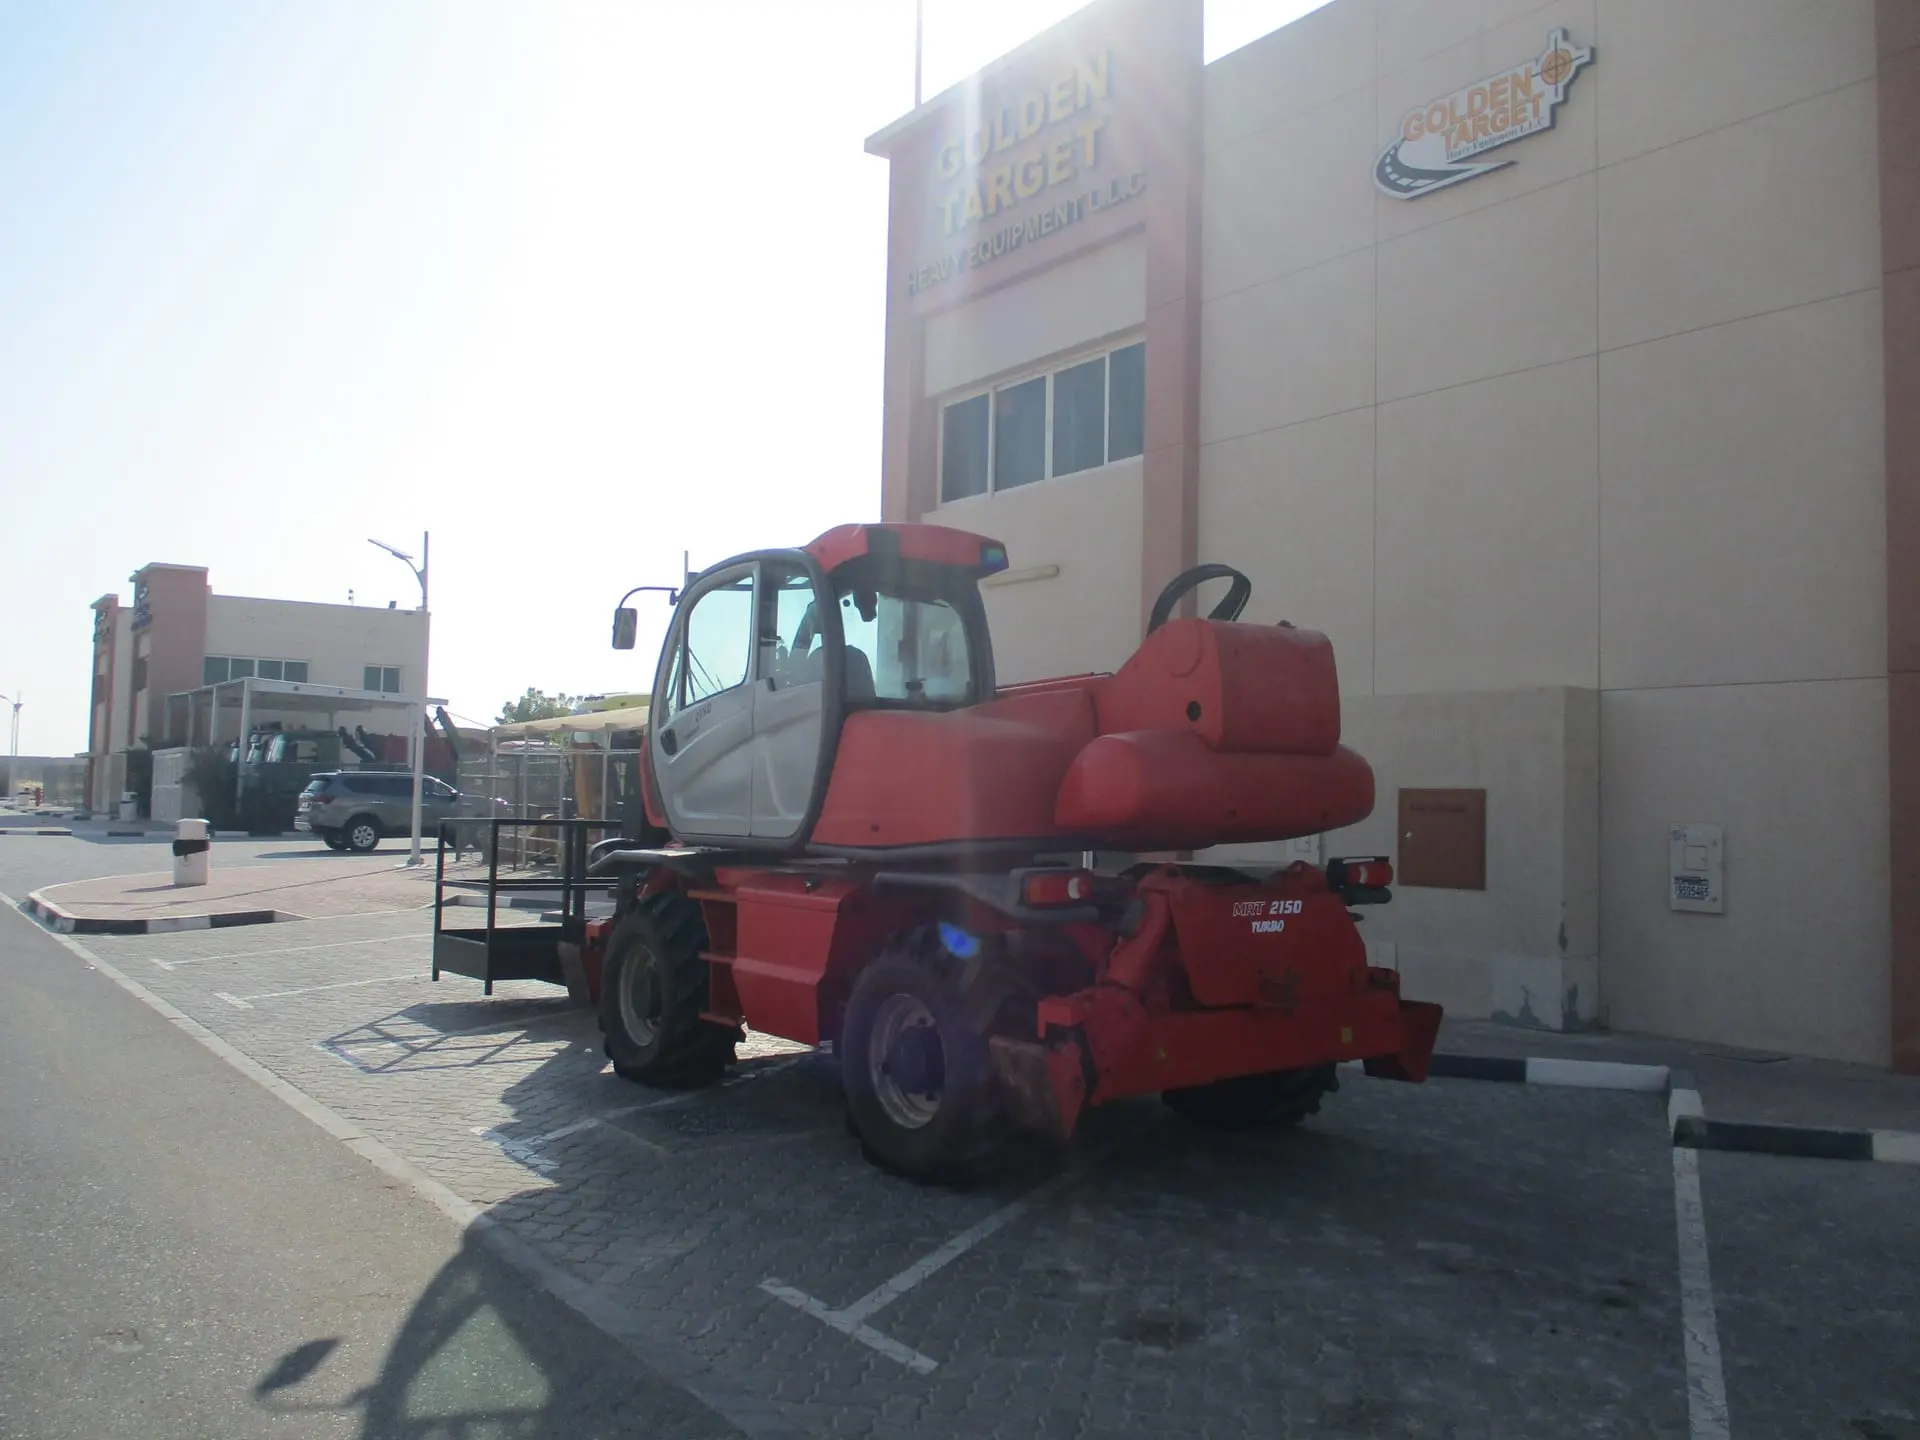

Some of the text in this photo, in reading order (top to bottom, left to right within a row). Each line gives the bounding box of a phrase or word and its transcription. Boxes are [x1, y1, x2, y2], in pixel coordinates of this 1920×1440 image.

[937, 51, 1109, 179] GOLDEN
[1403, 66, 1532, 142] GOLDEN
[1442, 91, 1545, 151] TARGET
[937, 115, 1106, 237] TARGET
[908, 253, 966, 297] HEAVY
[968, 196, 1084, 270] EQUIPMENT
[1232, 900, 1303, 917] MRT 2150
[1251, 919, 1285, 933] TURBO
